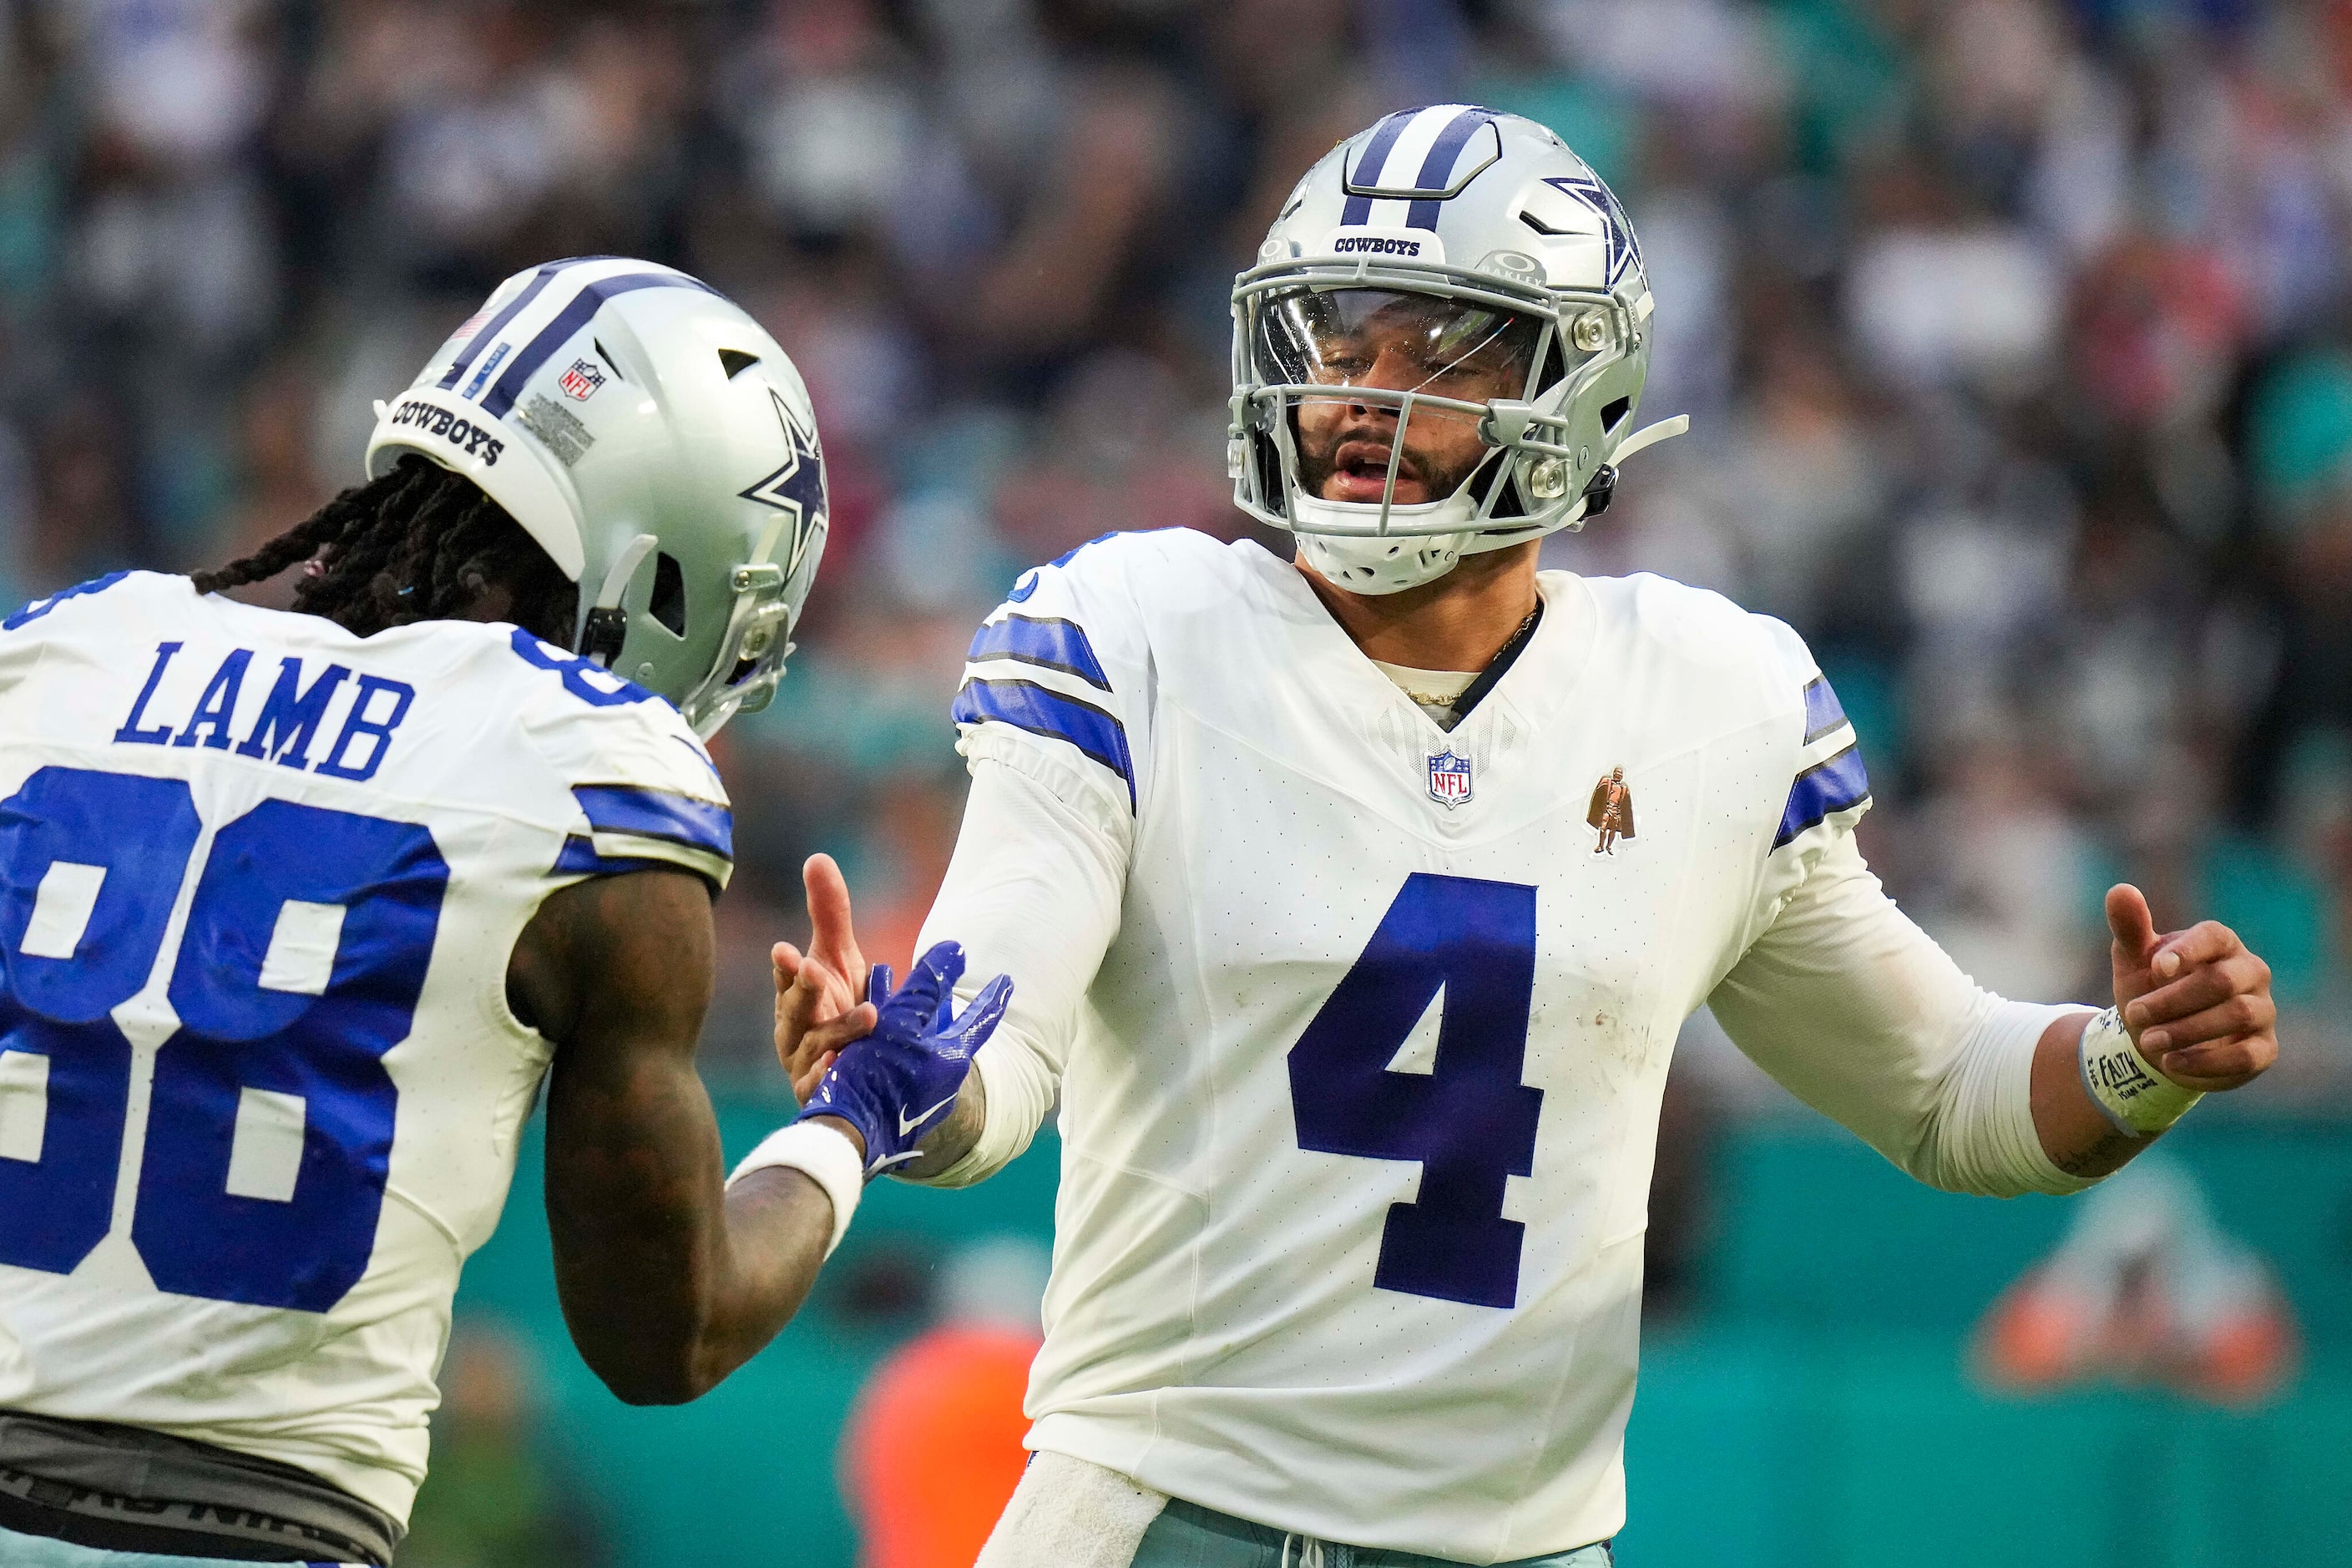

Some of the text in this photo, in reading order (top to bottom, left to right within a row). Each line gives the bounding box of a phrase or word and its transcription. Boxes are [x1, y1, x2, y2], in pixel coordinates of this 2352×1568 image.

[1334, 238, 1420, 257] COWBOYS
[562, 371, 591, 398] NFL
[392, 401, 505, 466] COWBOYS
[114, 640, 417, 781] LAMB
[1434, 772, 1468, 797] NFL
[0, 765, 451, 1313] 88
[1287, 872, 1545, 1309] 4
[2098, 1050, 2142, 1088] FAITH
